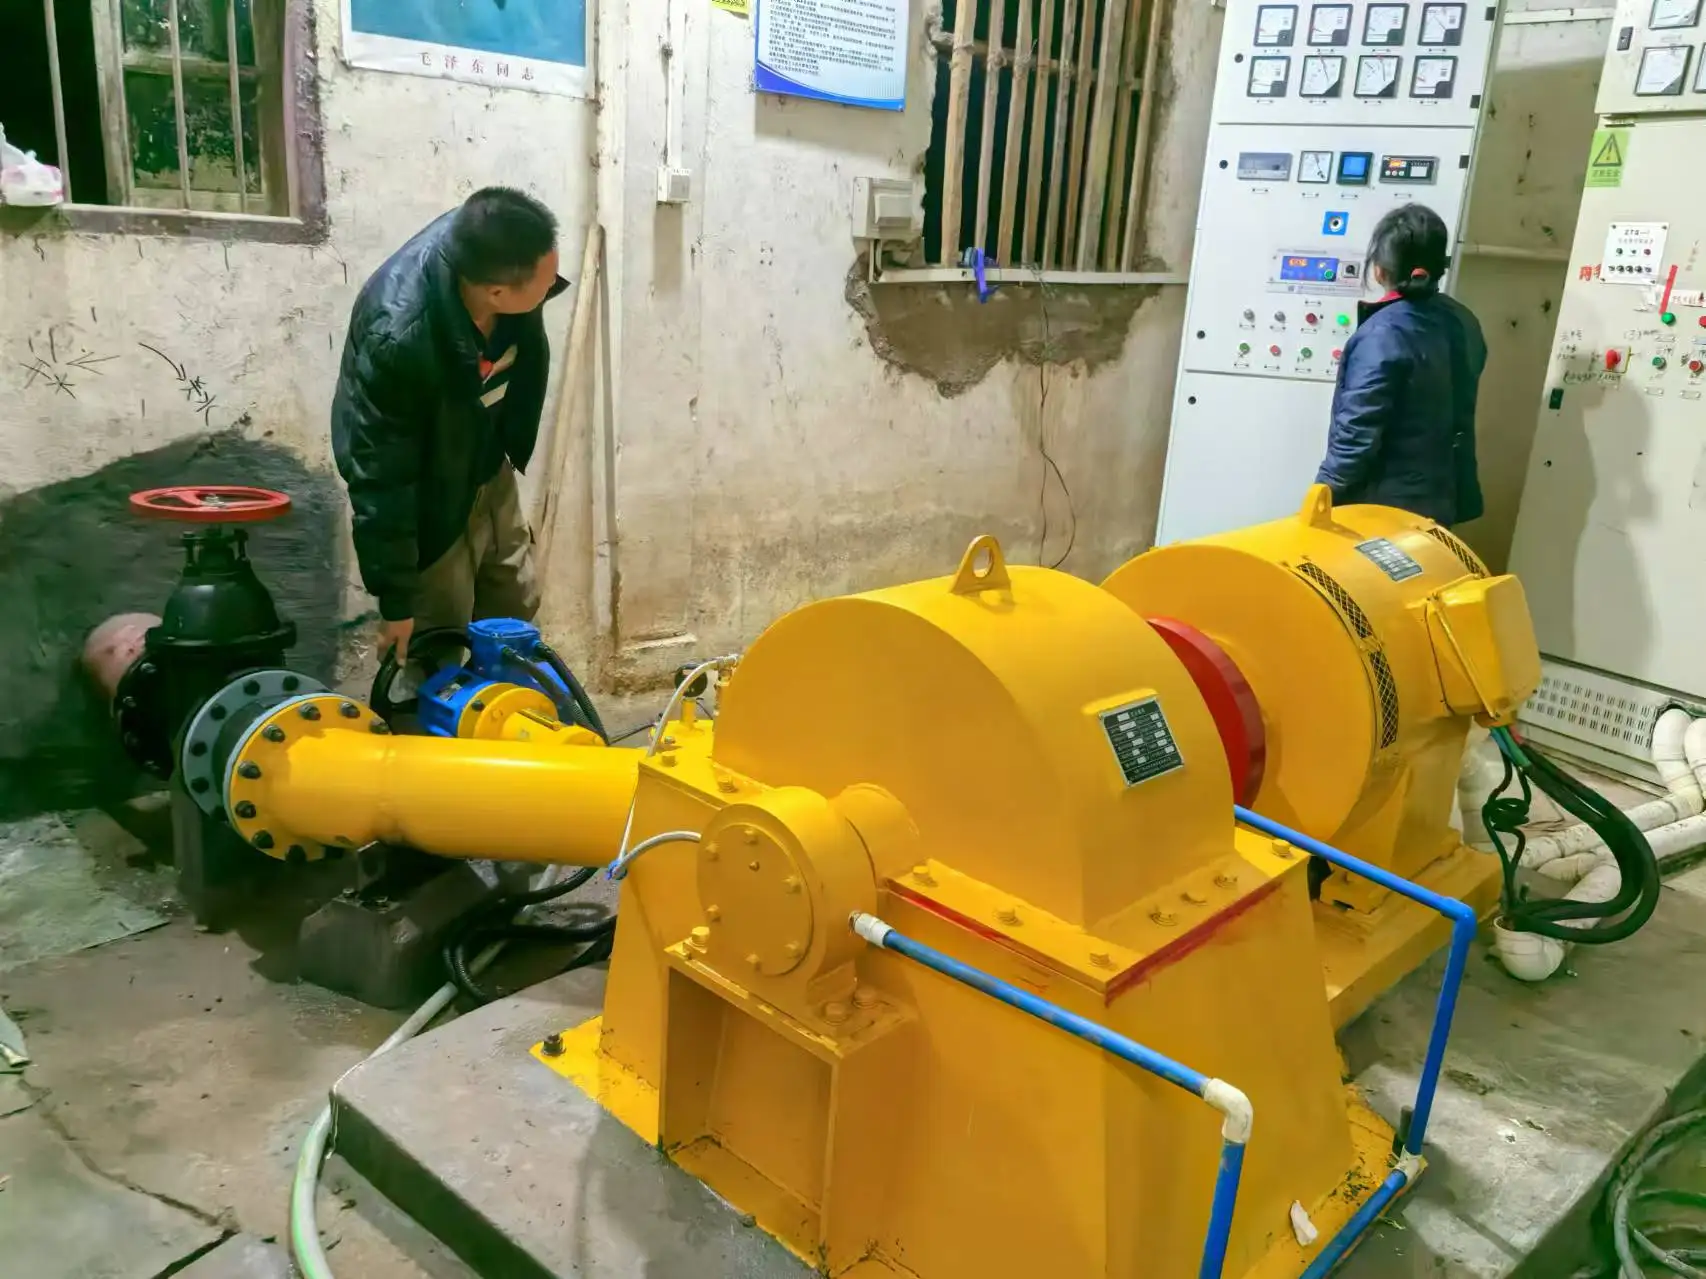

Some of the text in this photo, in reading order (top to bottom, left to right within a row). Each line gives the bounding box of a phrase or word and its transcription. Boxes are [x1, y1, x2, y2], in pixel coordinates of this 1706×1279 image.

[419, 52, 534, 81] 毛泽东同志
